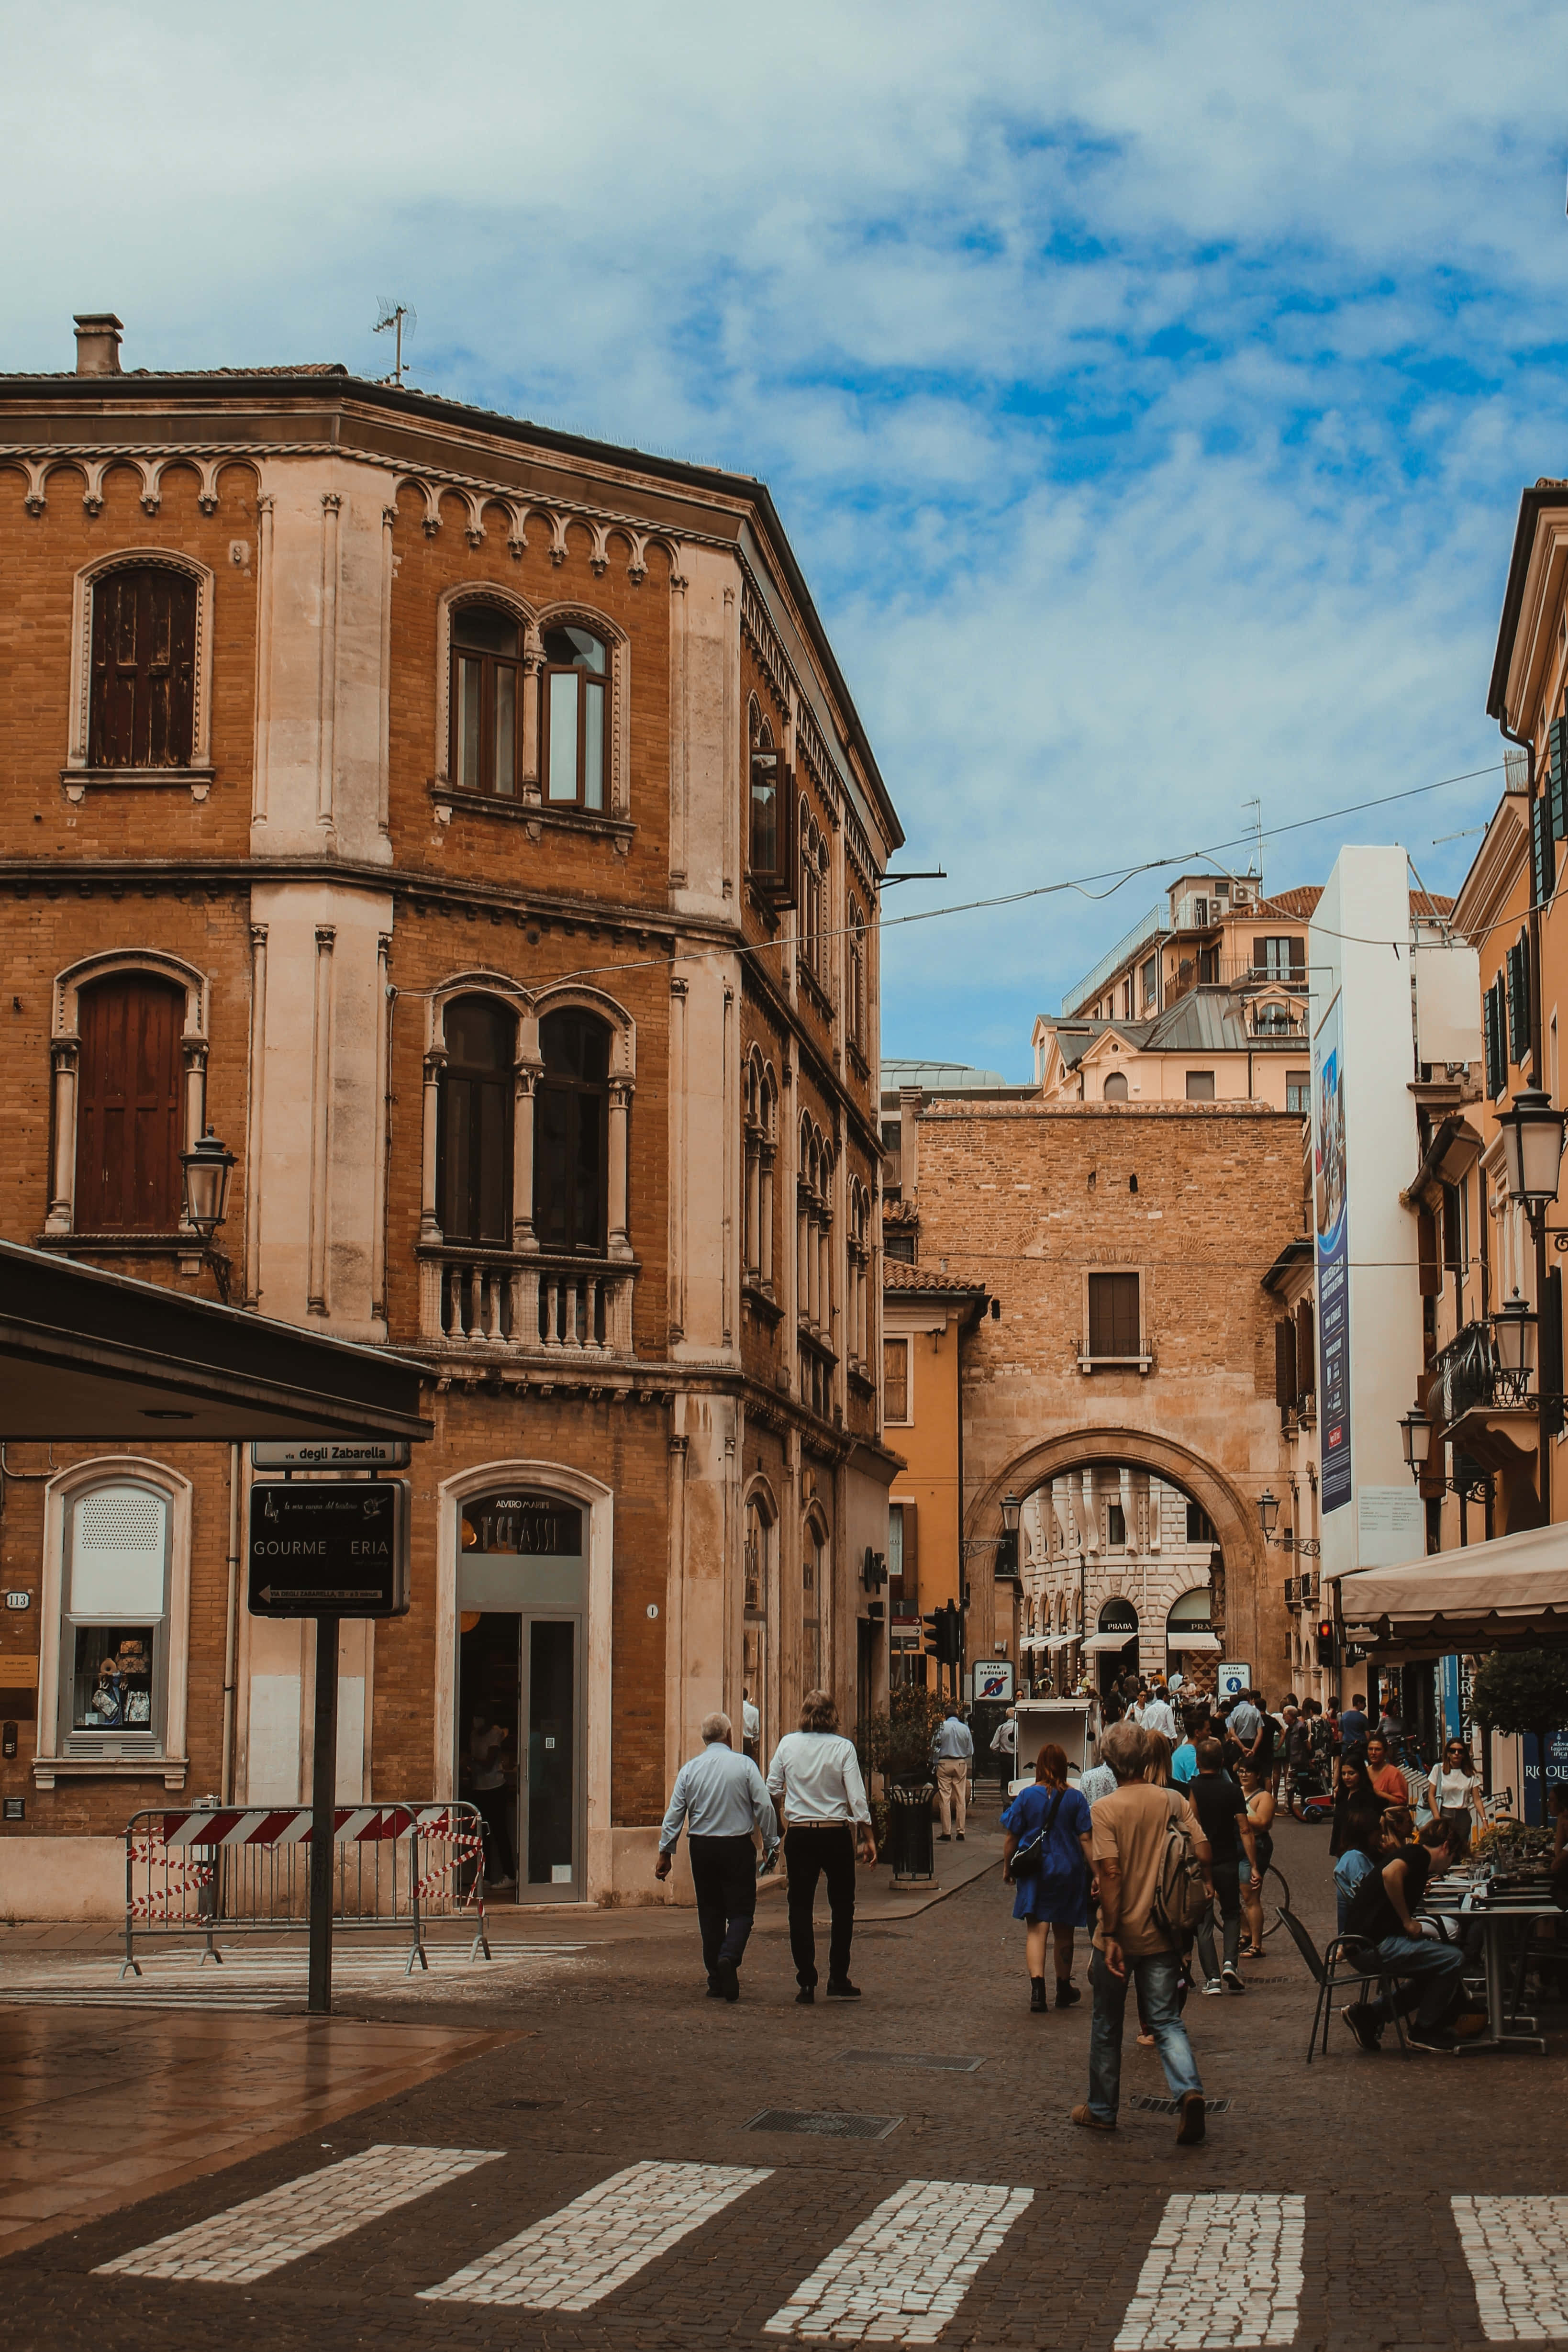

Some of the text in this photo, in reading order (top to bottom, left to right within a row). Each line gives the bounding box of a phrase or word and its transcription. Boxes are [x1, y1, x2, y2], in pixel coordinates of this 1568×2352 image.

[299, 1448, 328, 1460] degli
[332, 1447, 386, 1459] Zabarella
[10, 1595, 26, 1605] 113
